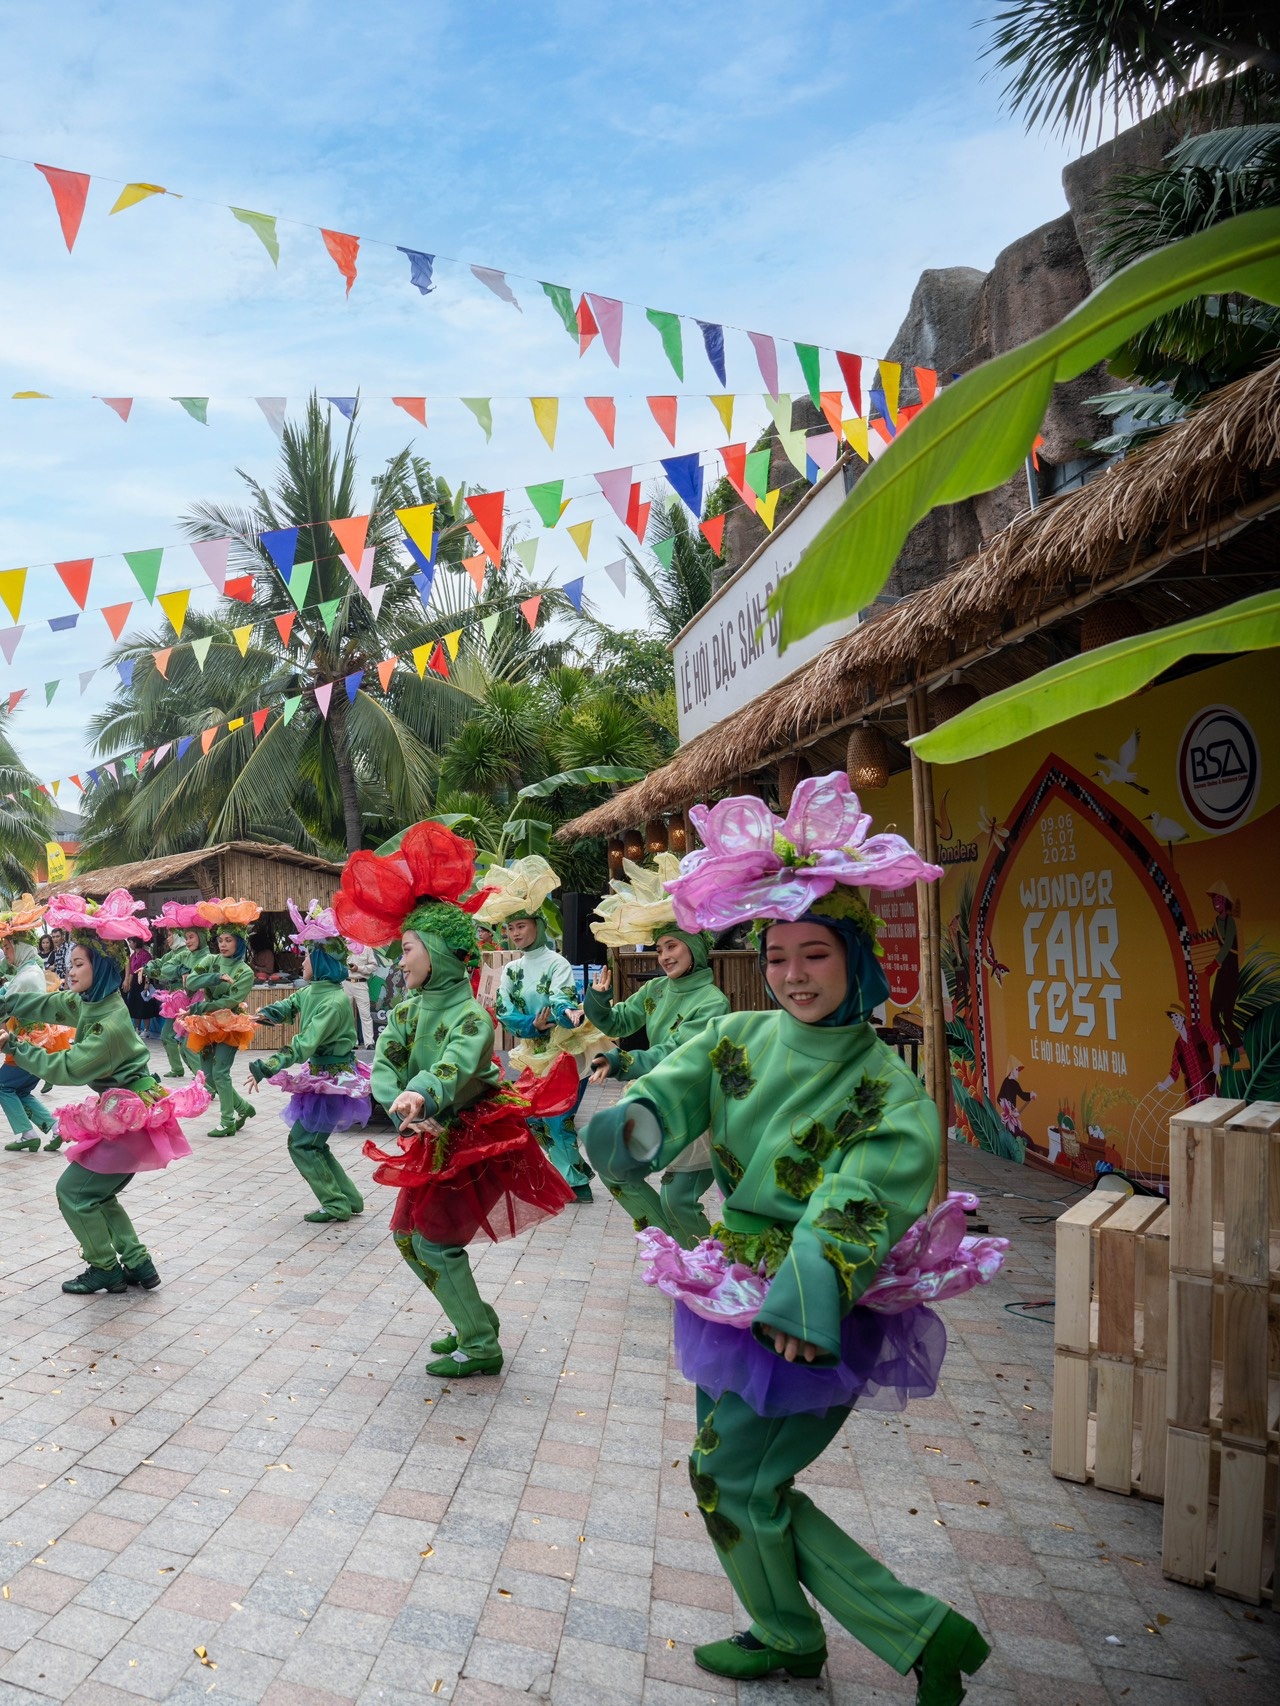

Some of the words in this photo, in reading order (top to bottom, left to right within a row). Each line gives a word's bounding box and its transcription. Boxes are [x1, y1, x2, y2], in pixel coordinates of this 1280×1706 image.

[680, 650, 692, 714] LỄ
[692, 641, 711, 707] HỘI
[712, 620, 736, 692] ĐẶC
[738, 592, 764, 670] SẢN
[1191, 739, 1248, 782] BSA
[1041, 814, 1072, 832] 09.06
[1041, 829, 1075, 847] 16.07
[1043, 845, 1076, 864] 2023
[1023, 908, 1121, 990] FAIR
[1041, 1038, 1053, 1064] HỘI
[1055, 1037, 1070, 1067] ĐẶC
[1073, 1039, 1089, 1069] SẢN
[1092, 1043, 1109, 1072] BẢN
[1112, 1051, 1127, 1077] ĐỊA
